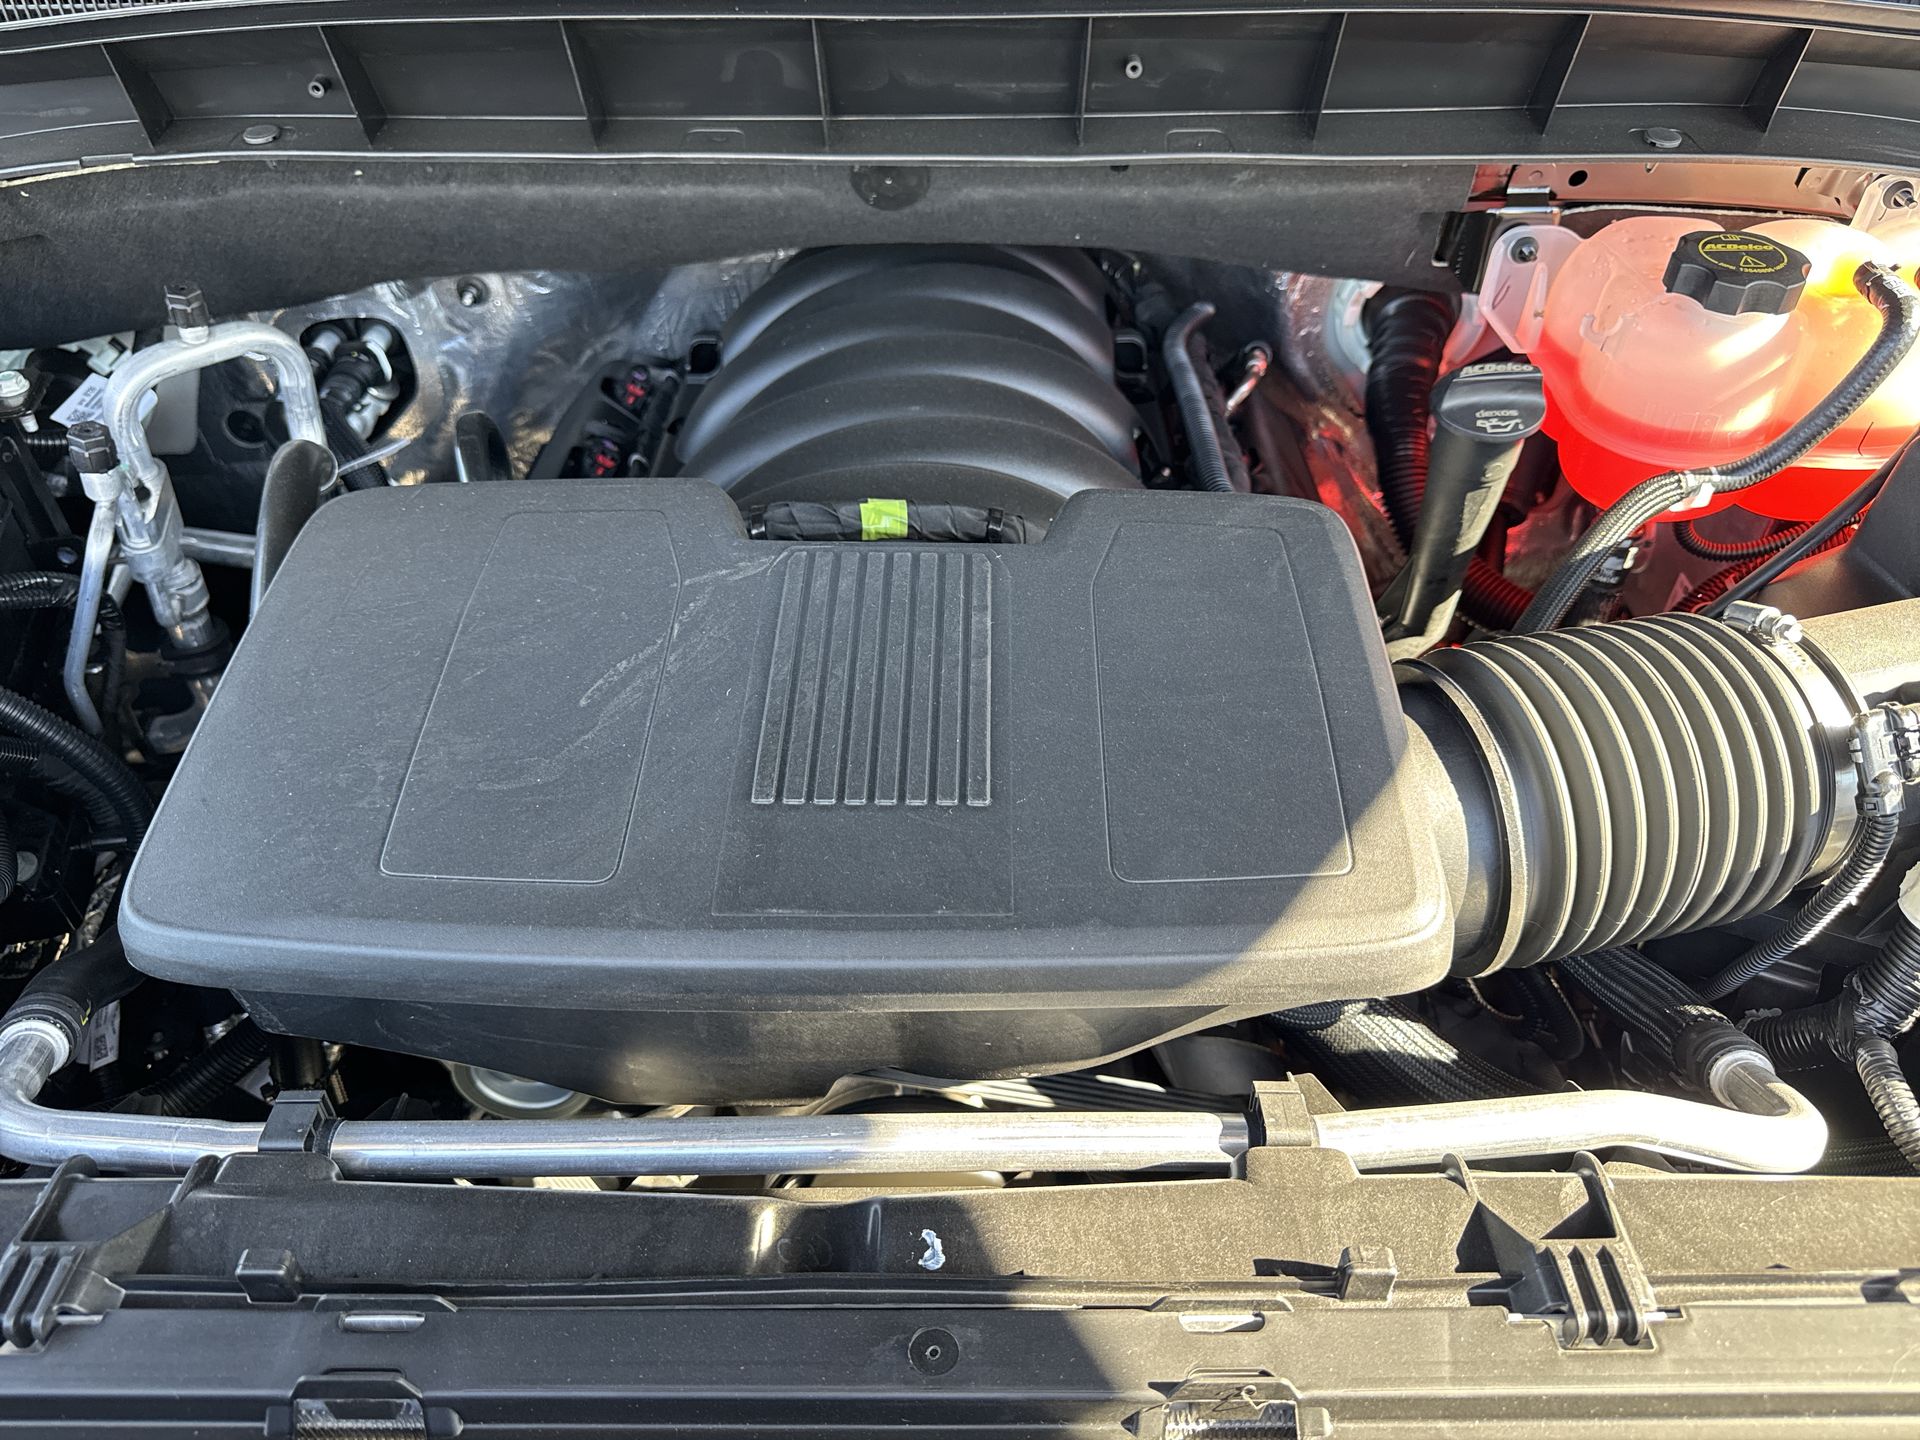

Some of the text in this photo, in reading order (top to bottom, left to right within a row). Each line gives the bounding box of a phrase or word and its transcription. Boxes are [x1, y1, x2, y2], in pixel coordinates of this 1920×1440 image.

[1703, 243, 1774, 251] ACDelco
[1460, 362, 1534, 378] ACDelco
[1475, 409, 1519, 419] dexos
